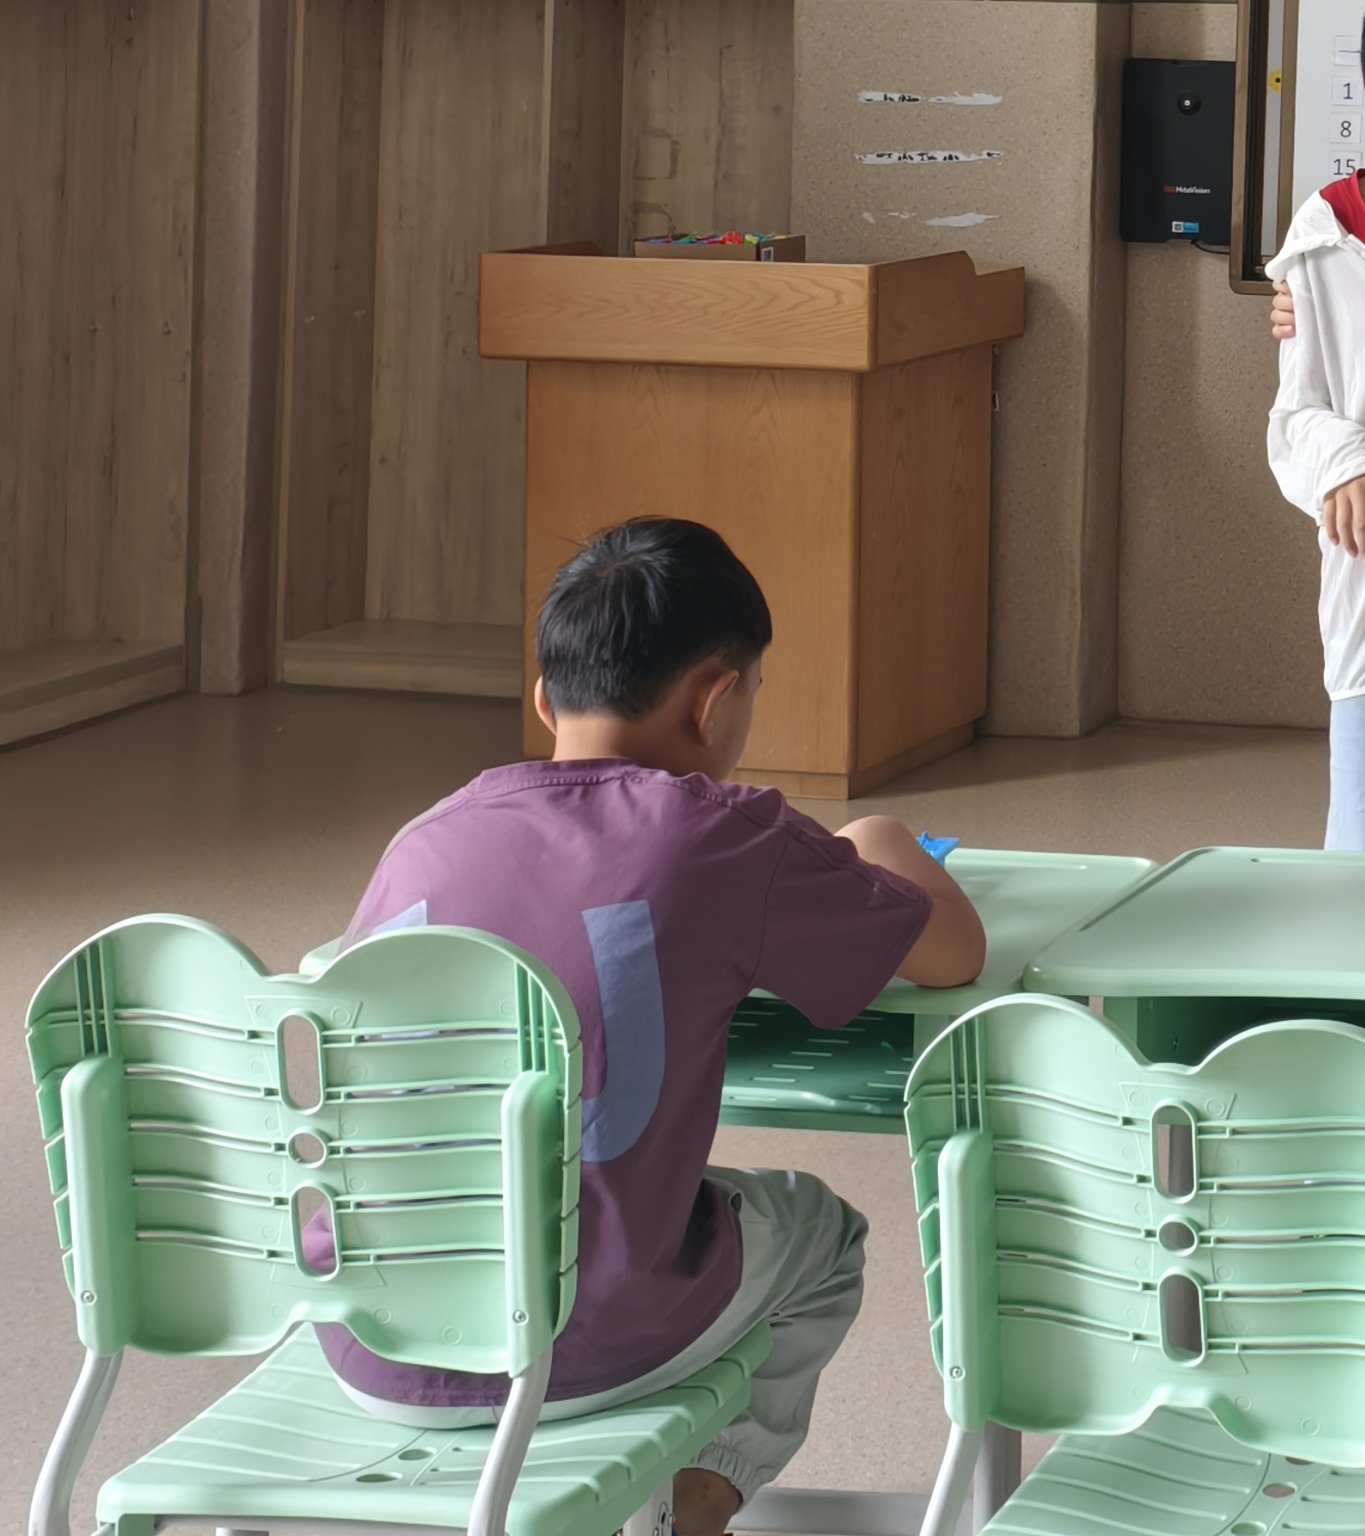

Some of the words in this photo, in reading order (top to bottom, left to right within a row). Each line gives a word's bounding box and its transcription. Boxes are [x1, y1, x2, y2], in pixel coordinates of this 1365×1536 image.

[1342, 82, 1354, 100] 1
[1339, 120, 1352, 138] 8
[1333, 157, 1357, 176] 15
